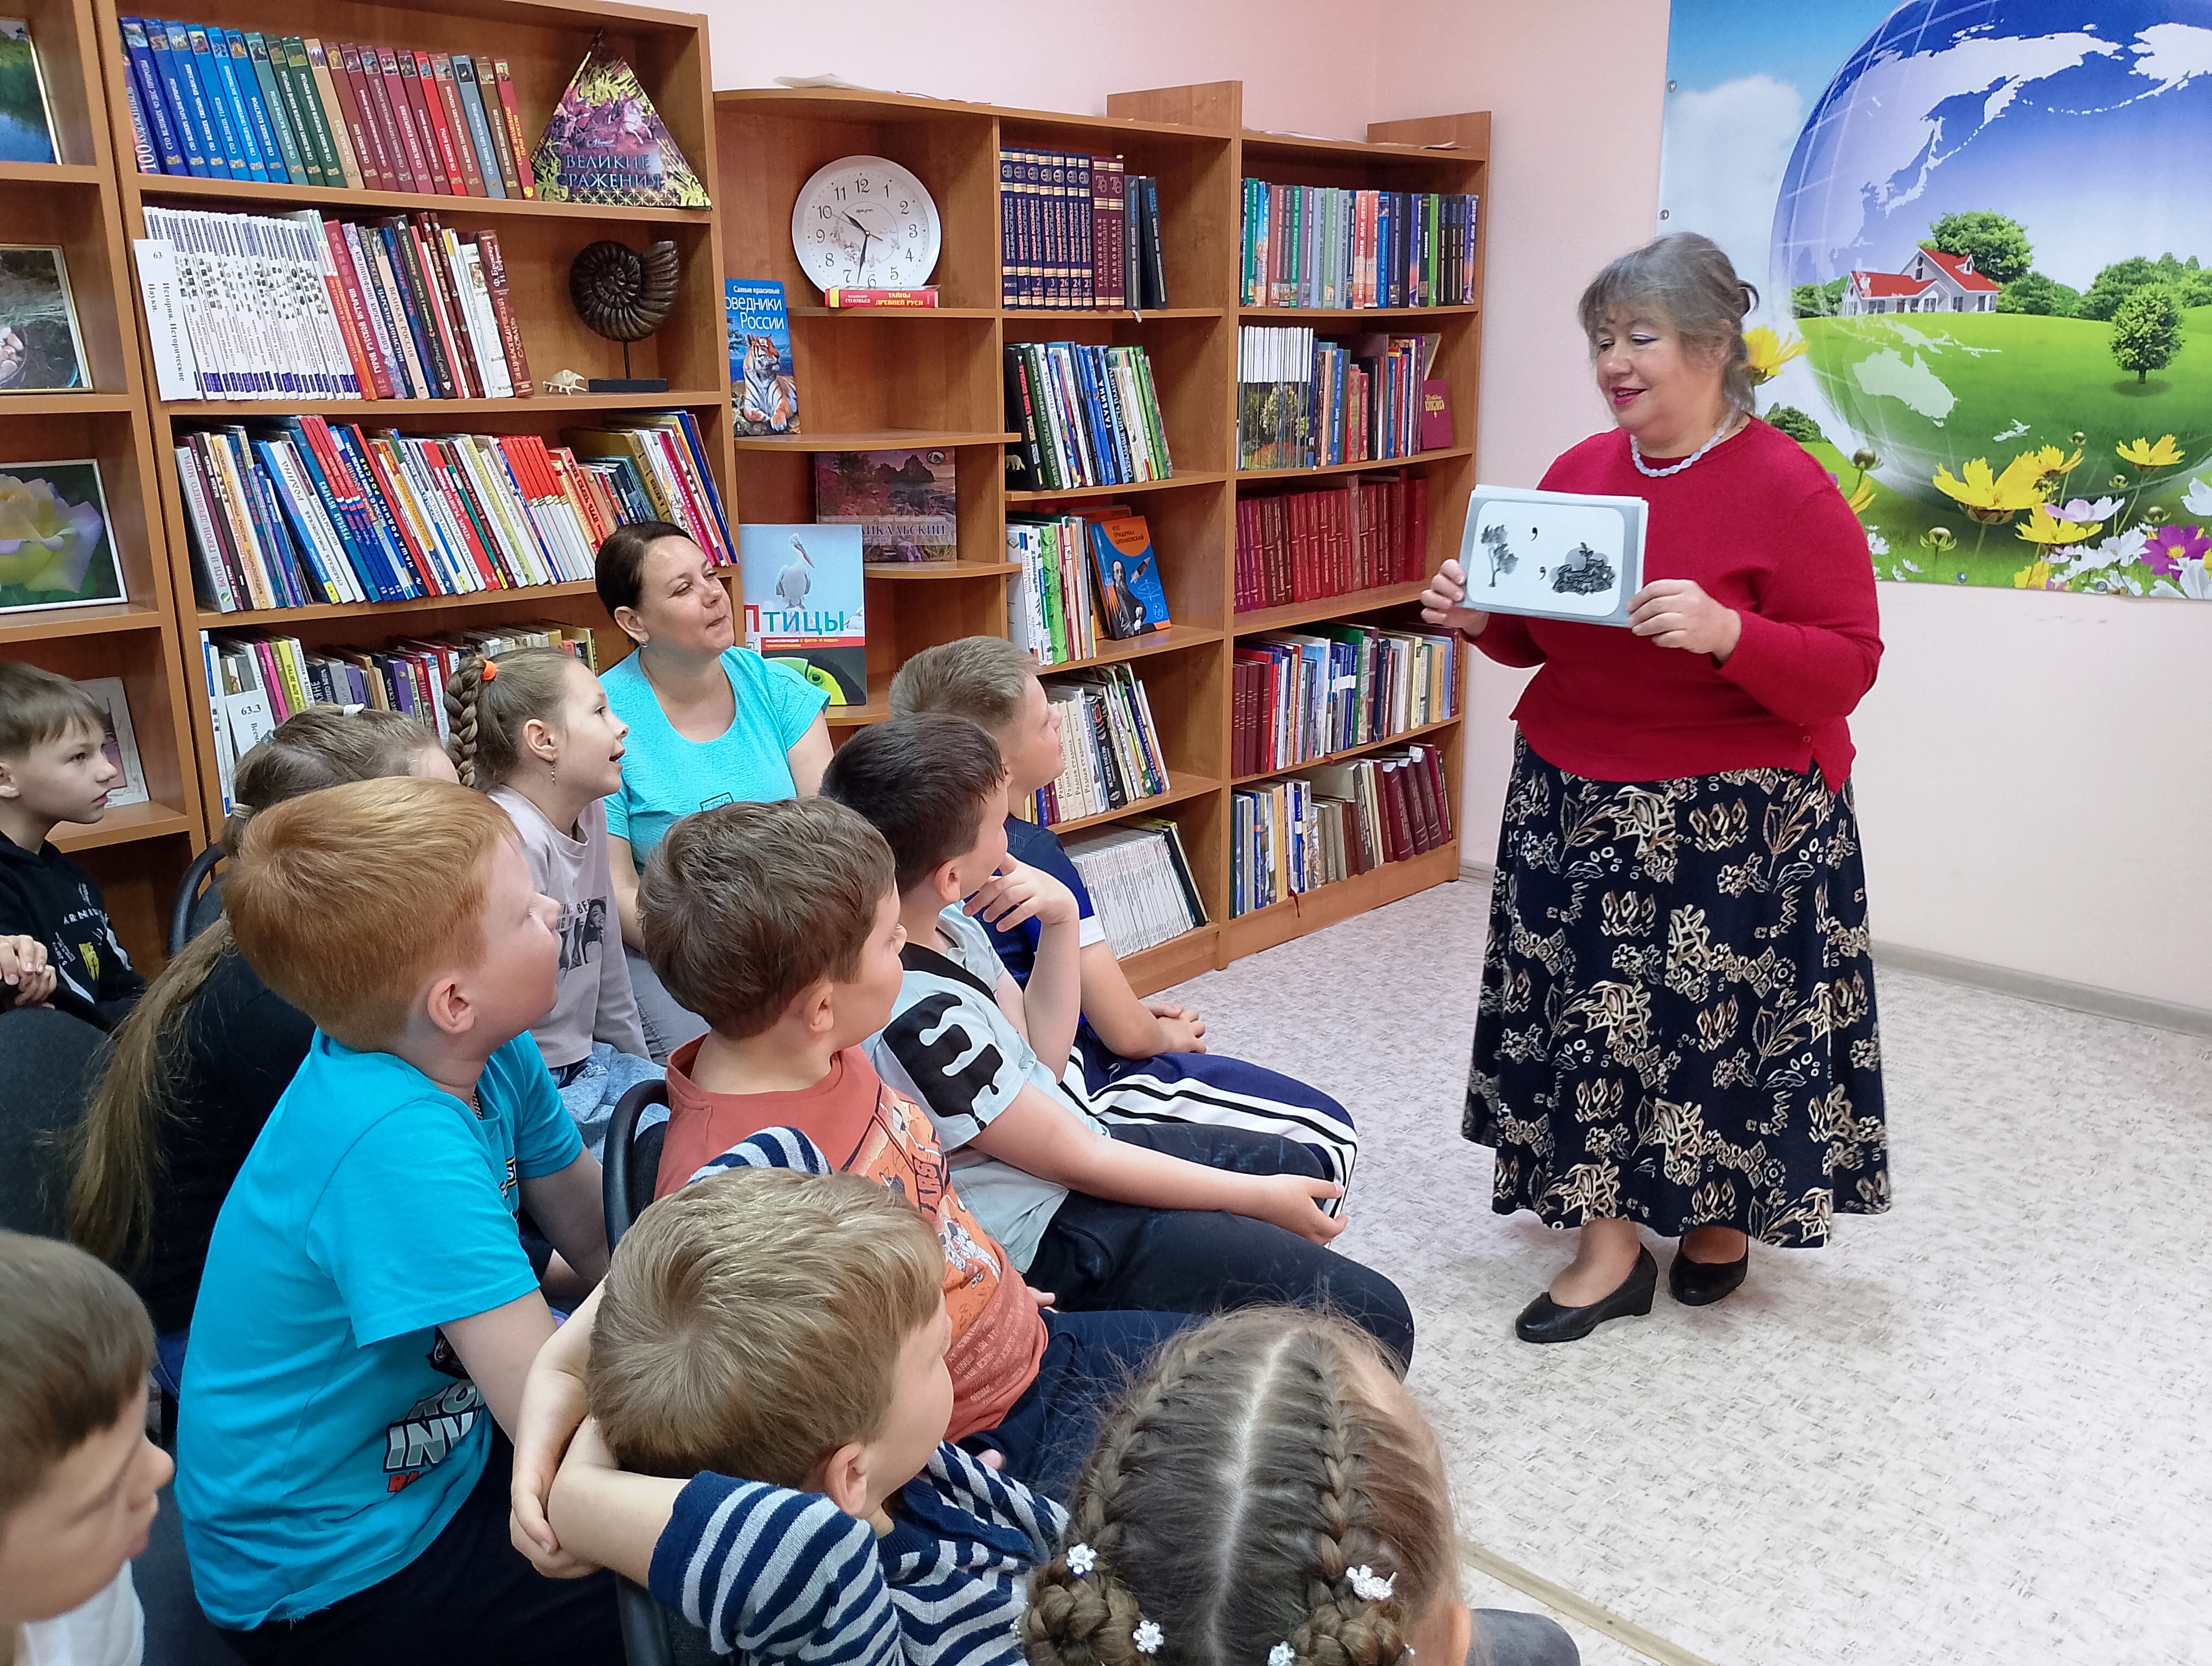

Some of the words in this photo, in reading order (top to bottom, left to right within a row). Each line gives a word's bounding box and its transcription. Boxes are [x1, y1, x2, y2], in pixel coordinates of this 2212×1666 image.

[140, 58, 155, 89] ПРИРОДЫ
[149, 89, 160, 108] ЧУДЕС
[156, 108, 169, 137] ВЕЛИКИХ
[134, 143, 157, 171] 100
[164, 136, 173, 150] СТО
[188, 141, 196, 151] СТО
[228, 142, 236, 154] СТО
[567, 155, 650, 170] ВЕЛИКИЕ
[555, 173, 661, 188] СРАЖЕНИЯ
[834, 186, 846, 201] 11
[854, 179, 870, 193] 12
[883, 184, 889, 198] 1
[817, 205, 832, 219] 10
[900, 201, 910, 215] 2
[816, 229, 825, 244] 9
[909, 224, 918, 238] 3
[484, 241, 498, 276] Брокгауз
[492, 244, 504, 271] Ефрон
[825, 252, 834, 267] 8
[905, 247, 914, 262] 4
[355, 250, 374, 300] МИФОЛОГИЯ
[843, 269, 852, 283] 7
[867, 274, 877, 287] 6
[890, 266, 898, 280] 5
[146, 283, 158, 313] Науки.
[348, 287, 364, 321] ИСТОРИИ
[733, 285, 752, 294] Самые
[753, 286, 780, 296] красивые
[161, 282, 175, 321] История.
[169, 323, 187, 382] Исторические
[358, 321, 374, 351] РУССКОЙ
[369, 302, 389, 350] СЛАВЯНСКАЯ
[376, 288, 392, 322] ЦАРСКИЕ
[387, 322, 405, 362] ДИНАСТИИ
[497, 296, 521, 381] ЭНЦИКЛОПЕДИЧЕСКИЙ
[509, 316, 524, 358] СЛОВАРЬ
[368, 352, 381, 374] ГЕРОИ
[1028, 349, 1039, 381] РОССИИ
[1107, 366, 1119, 404] ПЛАНЕТЫ
[1034, 382, 1047, 421] ПРИРОДЫ
[1097, 379, 1112, 428] ГЛУБИНА
[1115, 405, 1124, 430] МЕСТА
[1042, 422, 1052, 447] АТЛАС
[183, 454, 196, 478] МИРА
[567, 457, 579, 477] ВЕКА
[1047, 447, 1060, 486] БОЛЬШОЙ
[1120, 431, 1133, 477] САКРАЛЬНЫЕ
[281, 460, 305, 502] РОДИНА
[344, 441, 355, 457] МОЯ
[351, 456, 365, 479] ПЕРВАЯ
[361, 478, 373, 497] КНИГА
[372, 503, 387, 528] РОССИИ
[359, 456, 381, 495] РОССИЯ
[191, 481, 209, 524] ДРЕВНЕГО
[318, 479, 337, 510] ИСТОРИЯ
[576, 479, 590, 503] ЧЕРЕЗ
[313, 497, 327, 521] ГОРОДА
[324, 521, 338, 546] РОССИИ
[333, 511, 351, 541] РУССКАЯ
[378, 498, 400, 537] РОДИНА
[428, 495, 443, 522] ИСТОРИЯ
[440, 522, 454, 546] РОССИИ
[586, 503, 598, 522] ПУТЬ
[203, 526, 216, 553] ГЕРОИ
[227, 480, 241, 517] СОКРОВИЩА
[237, 519, 248, 542] РОССИИ
[245, 548, 262, 595] ЭНЦИКЛОПЕДИЯ
[304, 509, 326, 552] РОМАНОВСКИЙ
[438, 494, 446, 507] КЕМ
[446, 511, 454, 524] ЧЕМ
[451, 524, 467, 552] ГОРДИТСЯ
[464, 552, 477, 575] РОССИЯ
[397, 540, 414, 568] НАША
[213, 562, 226, 587] БОГИ
[325, 553, 343, 586] СТАНИСЛАВ
[286, 663, 295, 682] ДЕТЕЙ
[291, 683, 299, 695] ДЛЯ
[241, 704, 261, 716] 63.3
[1068, 739, 1077, 768] старина
[1076, 737, 1086, 766] старина
[1071, 769, 1081, 795] Родная
[1081, 767, 1090, 793] Родная
